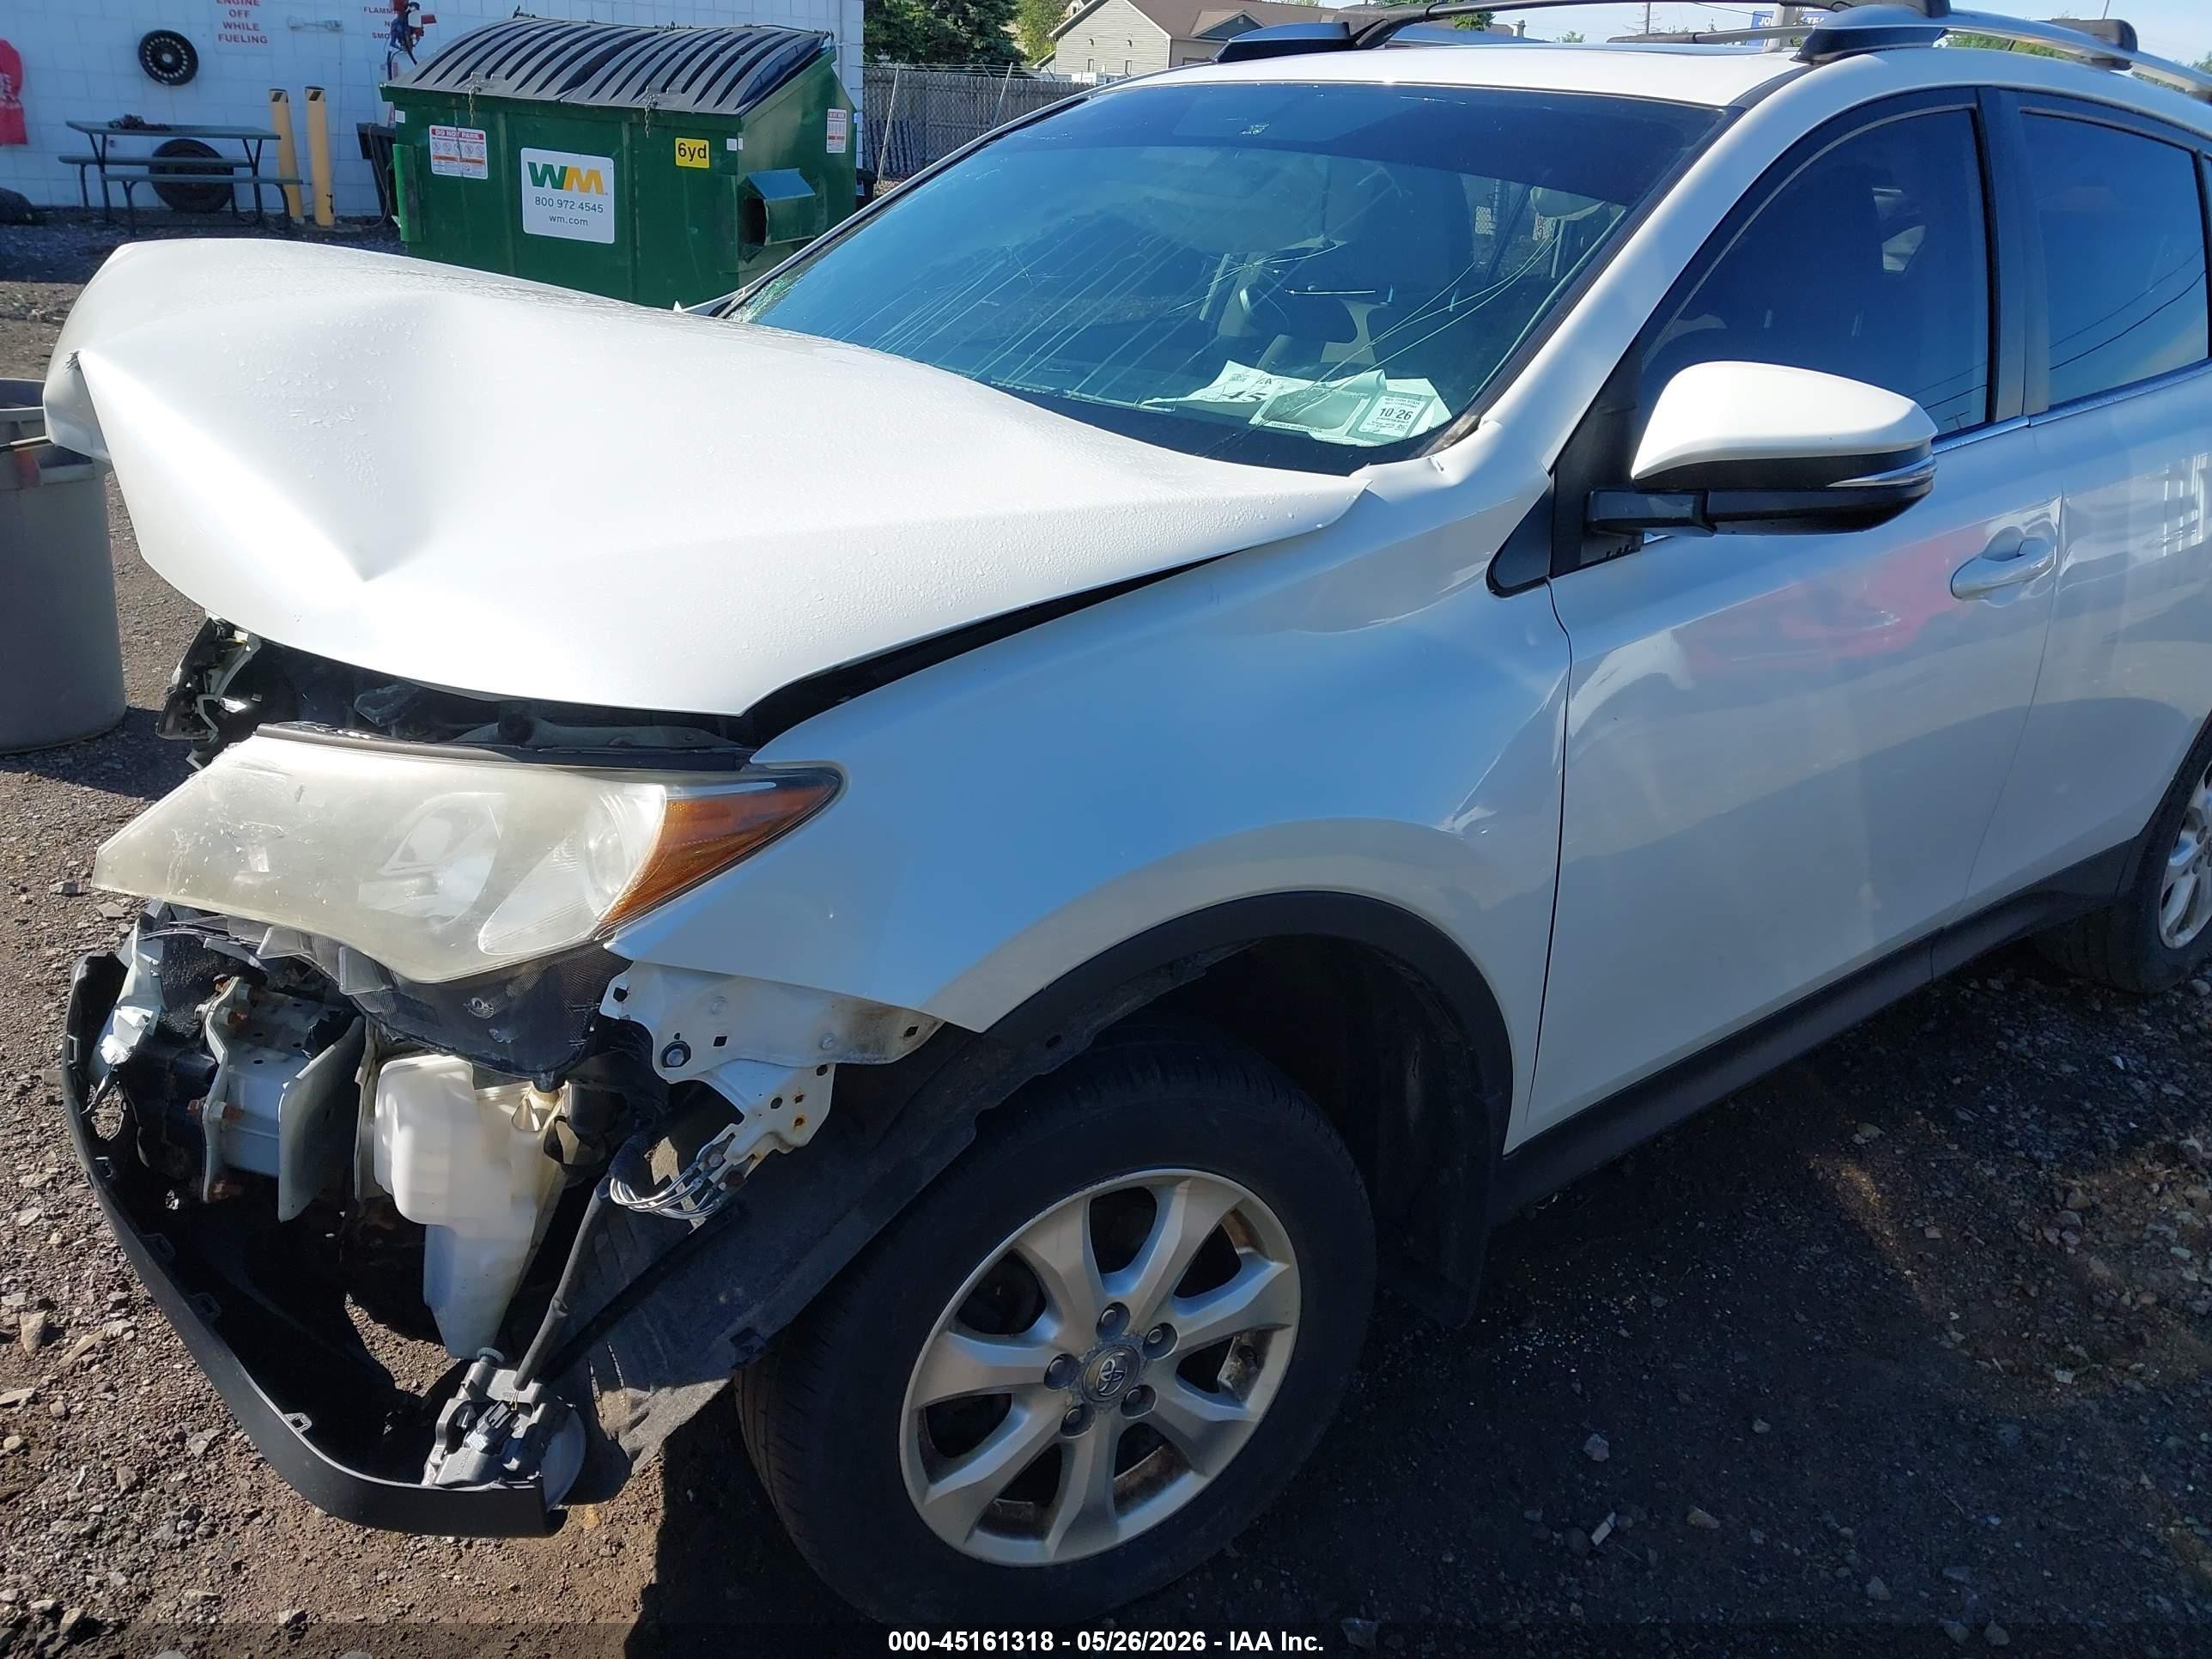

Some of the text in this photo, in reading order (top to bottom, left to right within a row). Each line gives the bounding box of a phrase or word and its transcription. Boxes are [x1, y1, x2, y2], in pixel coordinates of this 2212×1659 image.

[228, 9, 250, 18] OFF
[222, 21, 261, 31] WHILE
[217, 33, 268, 44] FUELING
[678, 142, 707, 162] 6yd
[527, 161, 605, 196] WM
[534, 196, 604, 214] 800 972 4545
[549, 215, 588, 227] wm.com
